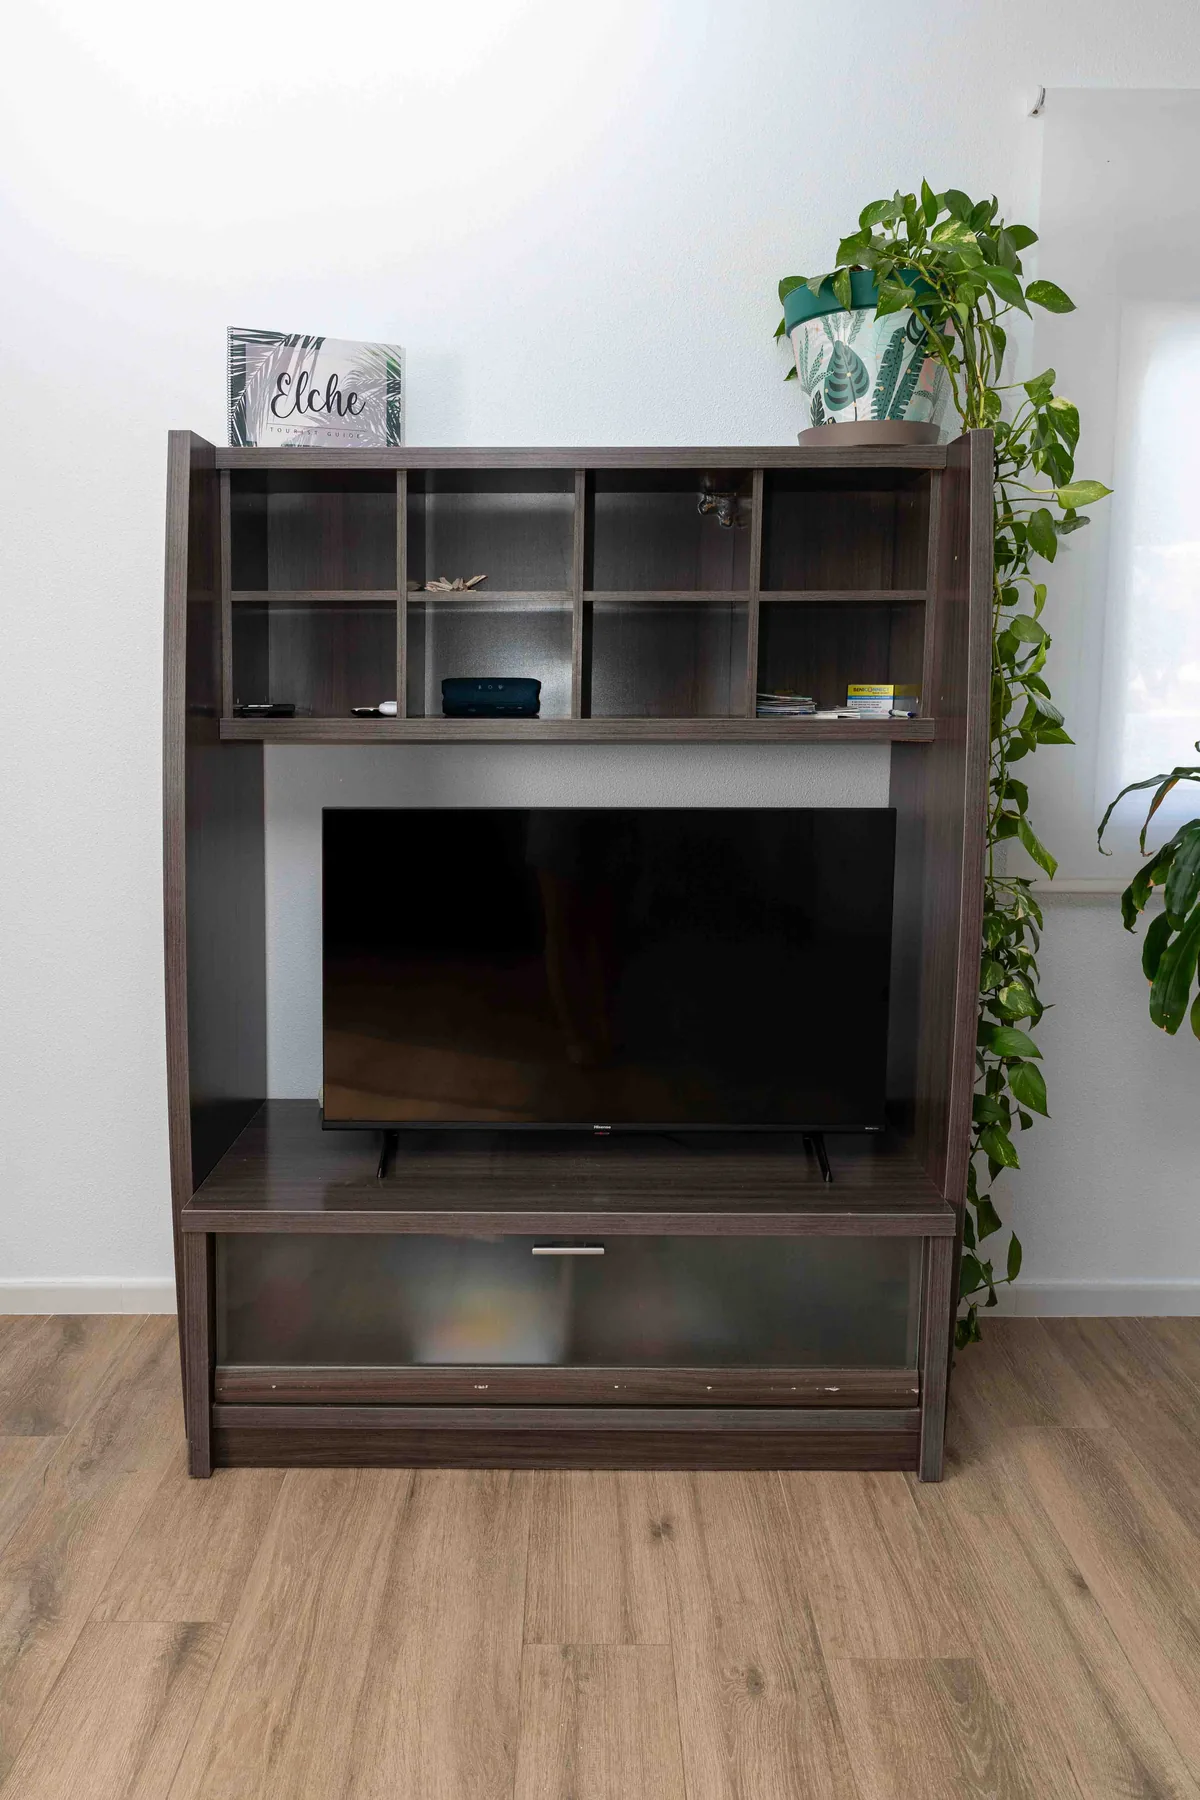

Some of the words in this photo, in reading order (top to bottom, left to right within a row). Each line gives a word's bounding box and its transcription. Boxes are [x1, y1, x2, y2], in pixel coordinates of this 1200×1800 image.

[270, 371, 366, 419] Elche
[270, 427, 318, 435] TOURIST
[327, 431, 361, 439] GUIDE
